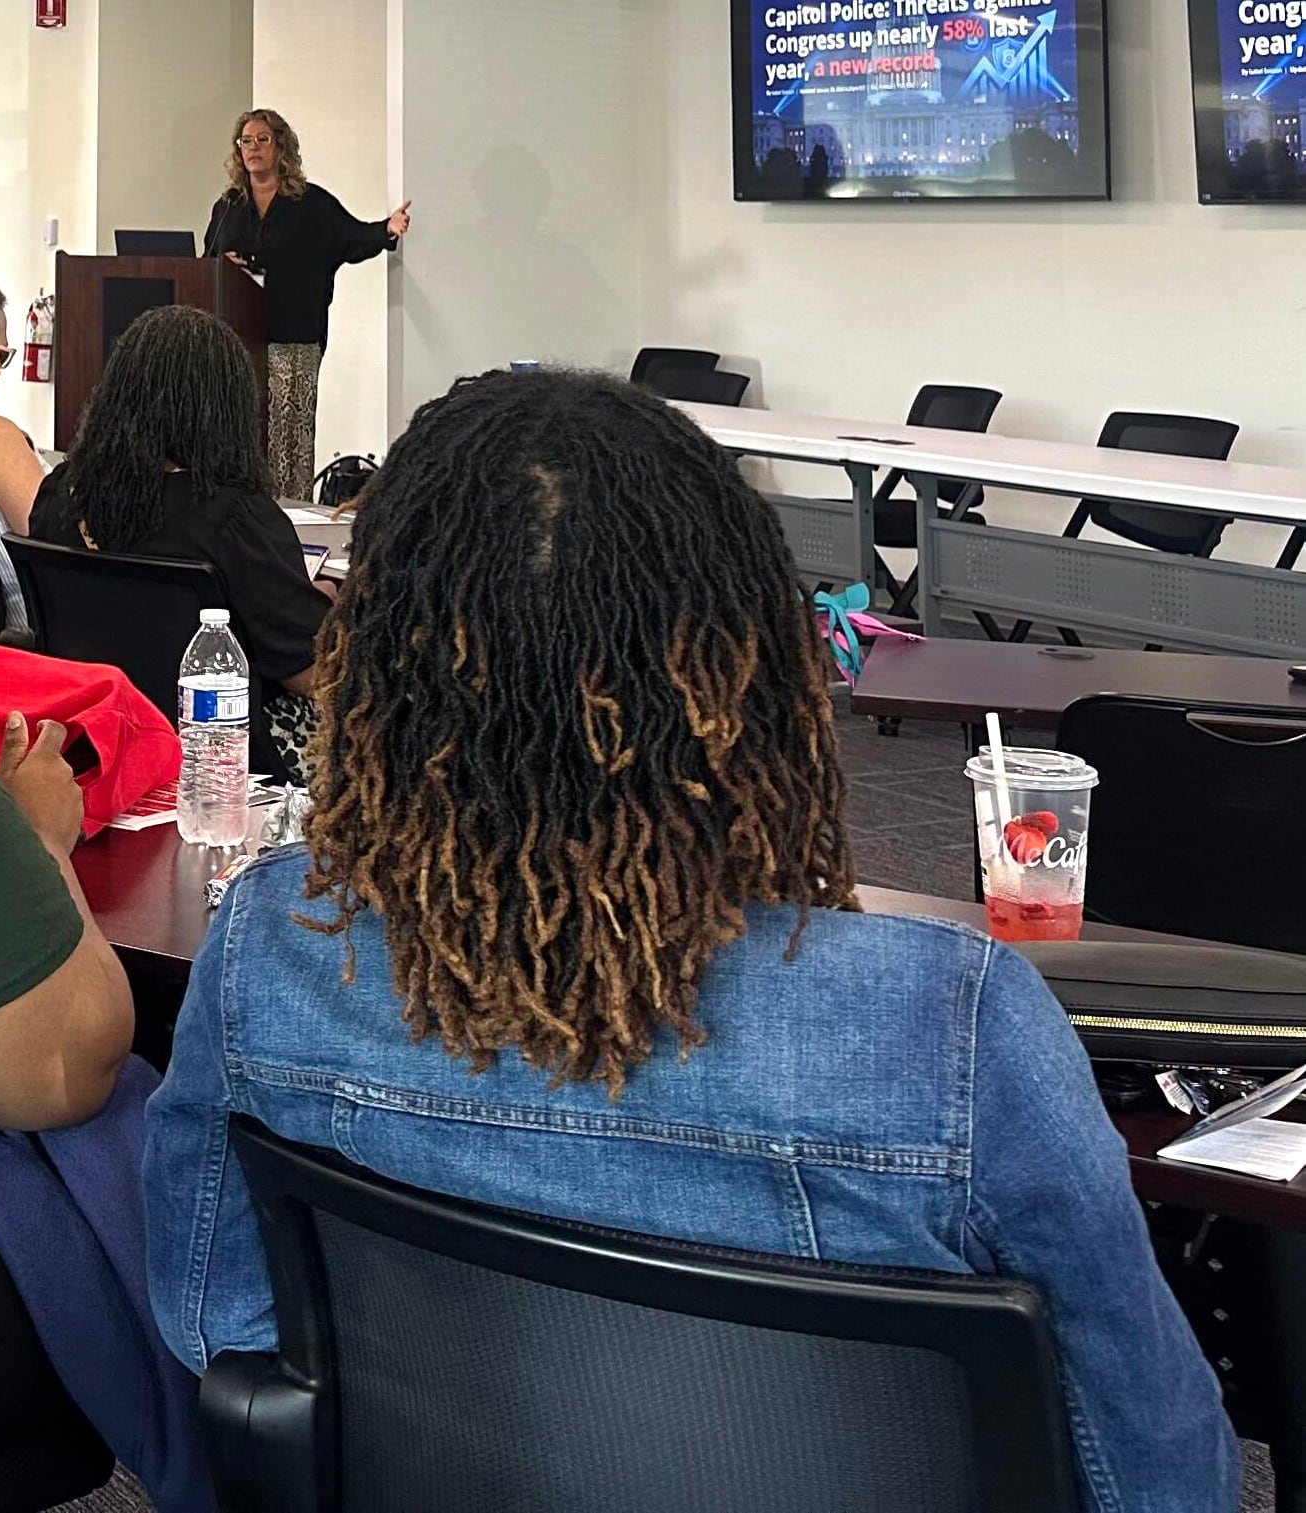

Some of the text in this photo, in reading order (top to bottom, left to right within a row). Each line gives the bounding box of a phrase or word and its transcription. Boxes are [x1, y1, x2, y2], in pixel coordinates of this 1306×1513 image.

[765, 1, 826, 31] Capitol
[831, 0, 890, 22] Police:
[895, 0, 969, 17] Threats
[766, 15, 1029, 57] Congress up nearly 58% last
[1239, 34, 1304, 64] year,
[765, 62, 810, 86] year,
[814, 61, 825, 77] a
[830, 58, 869, 77] new
